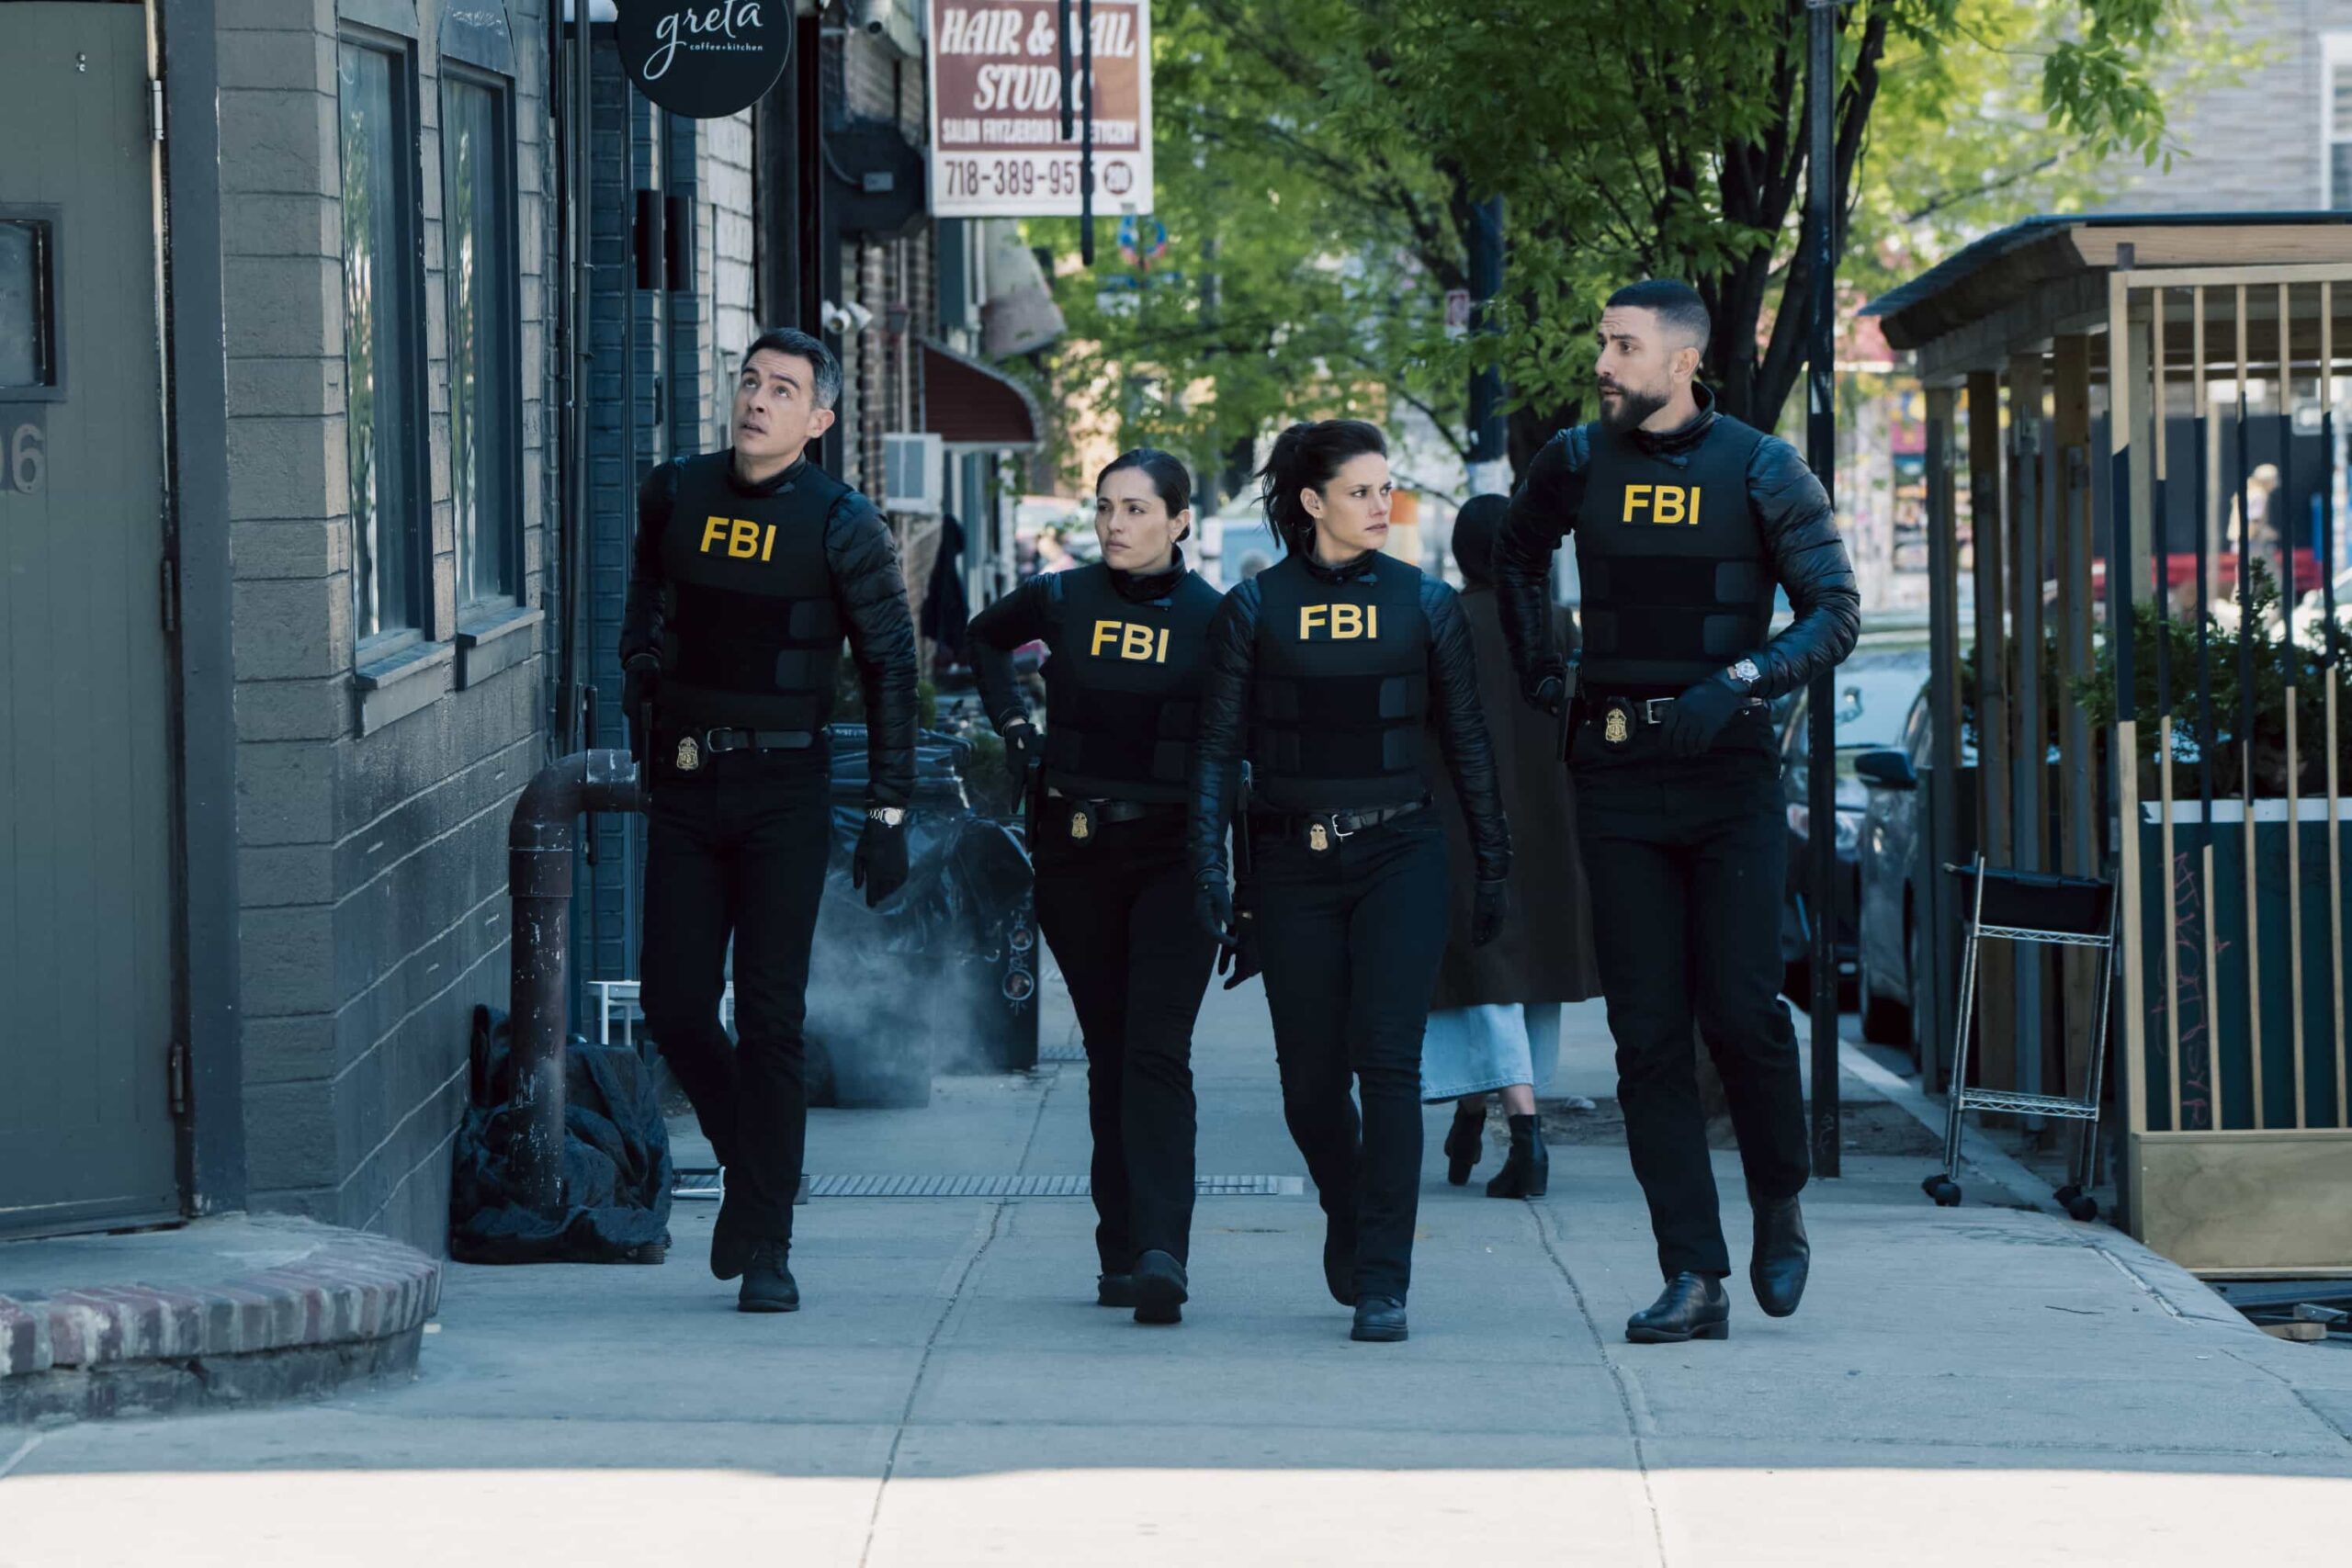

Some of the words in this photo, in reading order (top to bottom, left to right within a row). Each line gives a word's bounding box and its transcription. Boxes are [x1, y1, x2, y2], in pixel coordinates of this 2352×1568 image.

[643, 0, 763, 80] greta
[940, 8, 1023, 56] HAIR
[1026, 10, 1056, 56] &
[973, 63, 1095, 111] STUDO
[1623, 484, 1701, 525] FBI
[700, 515, 777, 562] FBI
[1091, 620, 1170, 663] FBI
[1299, 604, 1378, 640] FBI
